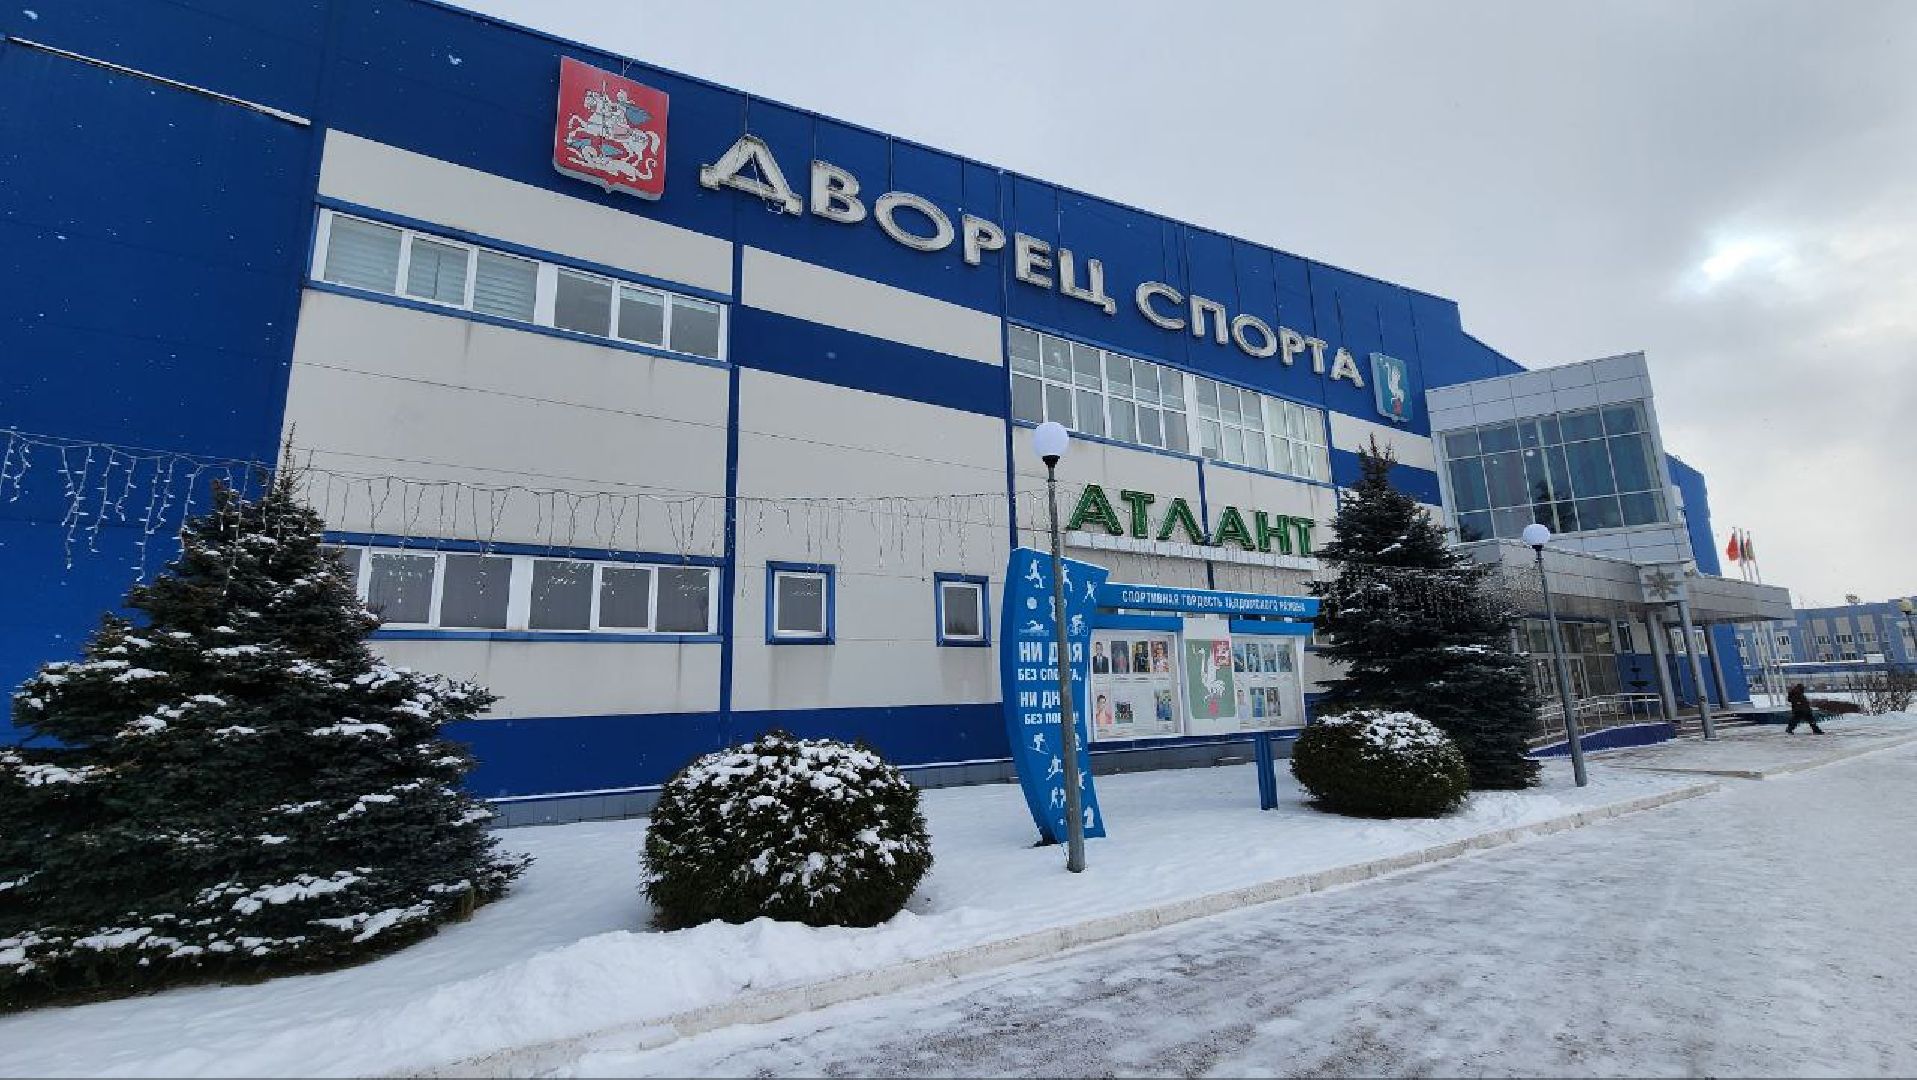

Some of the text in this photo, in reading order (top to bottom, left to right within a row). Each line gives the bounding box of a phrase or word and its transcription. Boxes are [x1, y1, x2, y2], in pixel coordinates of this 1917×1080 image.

[699, 133, 1365, 388] ДВОРЕЦ СПОРТА
[1065, 484, 1315, 557] АТЛАНТ
[1121, 590, 1179, 606] СПОРТИВНАЯ
[1182, 594, 1223, 608] ГОРДОСТЬ
[1018, 641, 1043, 663] НИ
[1017, 668, 1037, 681] БЕЗ
[1020, 689, 1061, 709] НИ ДН
[1024, 713, 1043, 725] БЕЗ
